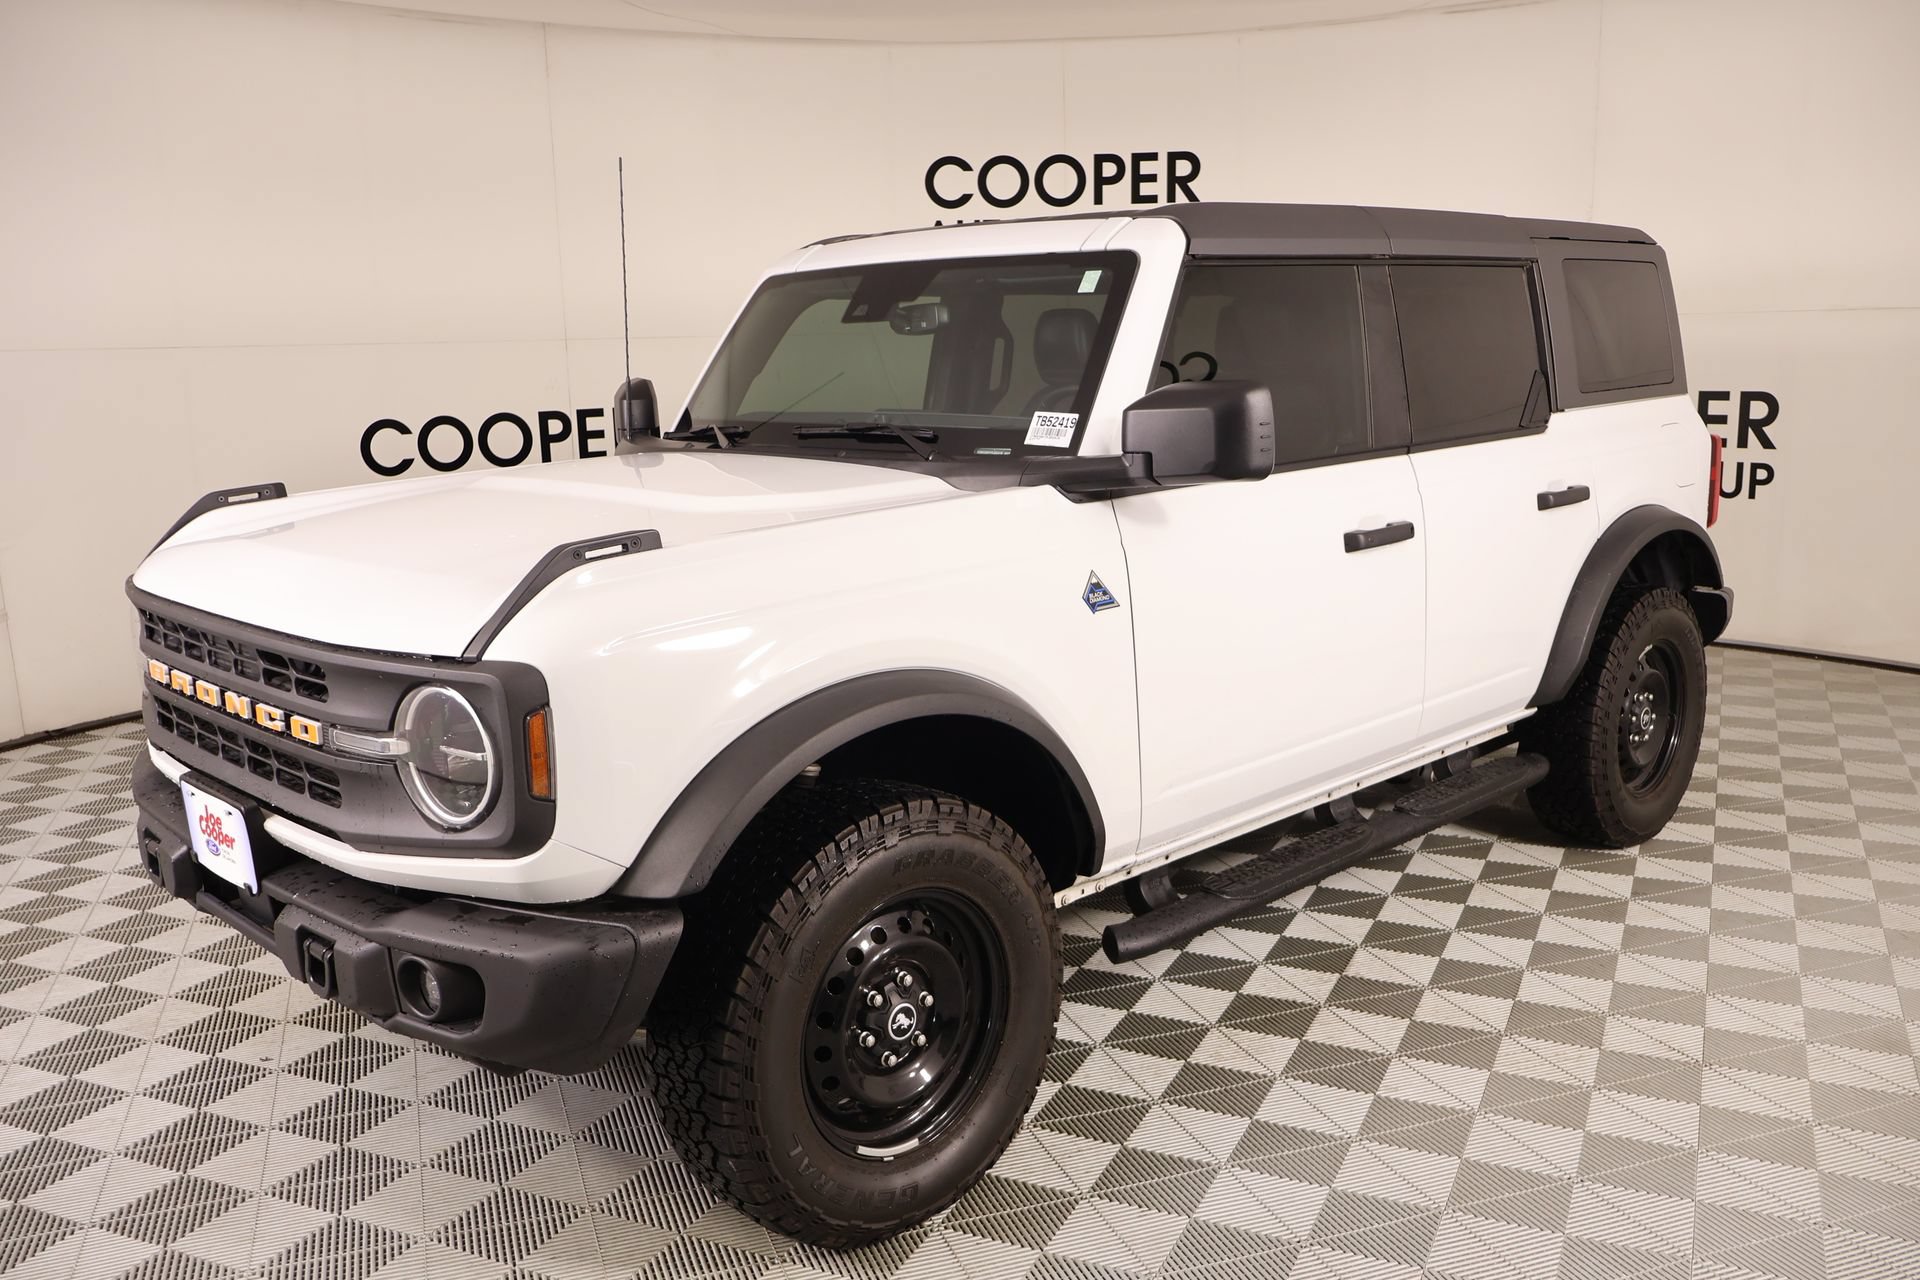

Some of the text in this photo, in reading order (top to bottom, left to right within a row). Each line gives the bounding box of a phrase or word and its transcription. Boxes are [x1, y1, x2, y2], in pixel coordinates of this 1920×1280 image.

[925, 151, 1201, 209] COOPER
[360, 408, 617, 476] COOPE
[1035, 415, 1077, 429] TB52419
[148, 658, 323, 746] BRONCO
[199, 814, 236, 850] Cooper
[204, 804, 223, 832] Joe
